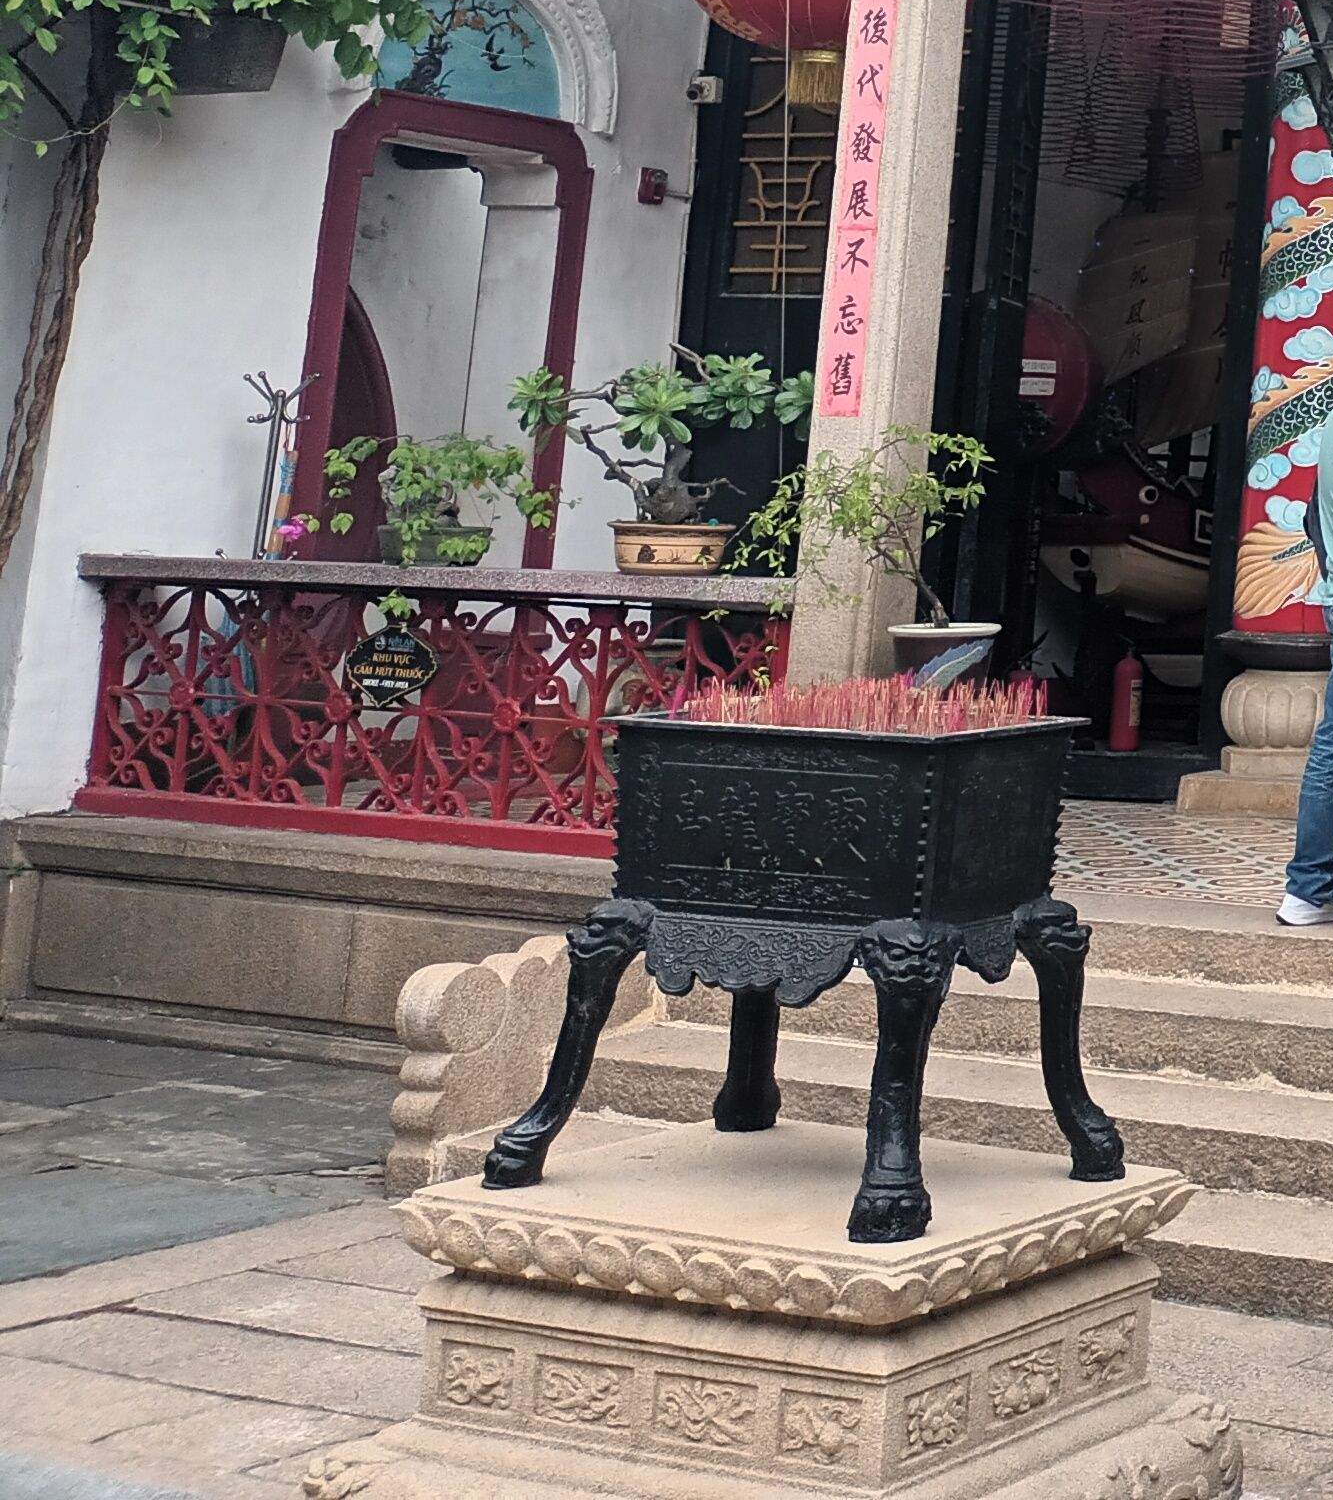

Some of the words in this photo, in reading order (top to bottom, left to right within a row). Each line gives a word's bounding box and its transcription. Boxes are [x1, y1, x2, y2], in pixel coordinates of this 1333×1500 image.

[827, 8, 890, 397] 後代發展不忘舊
